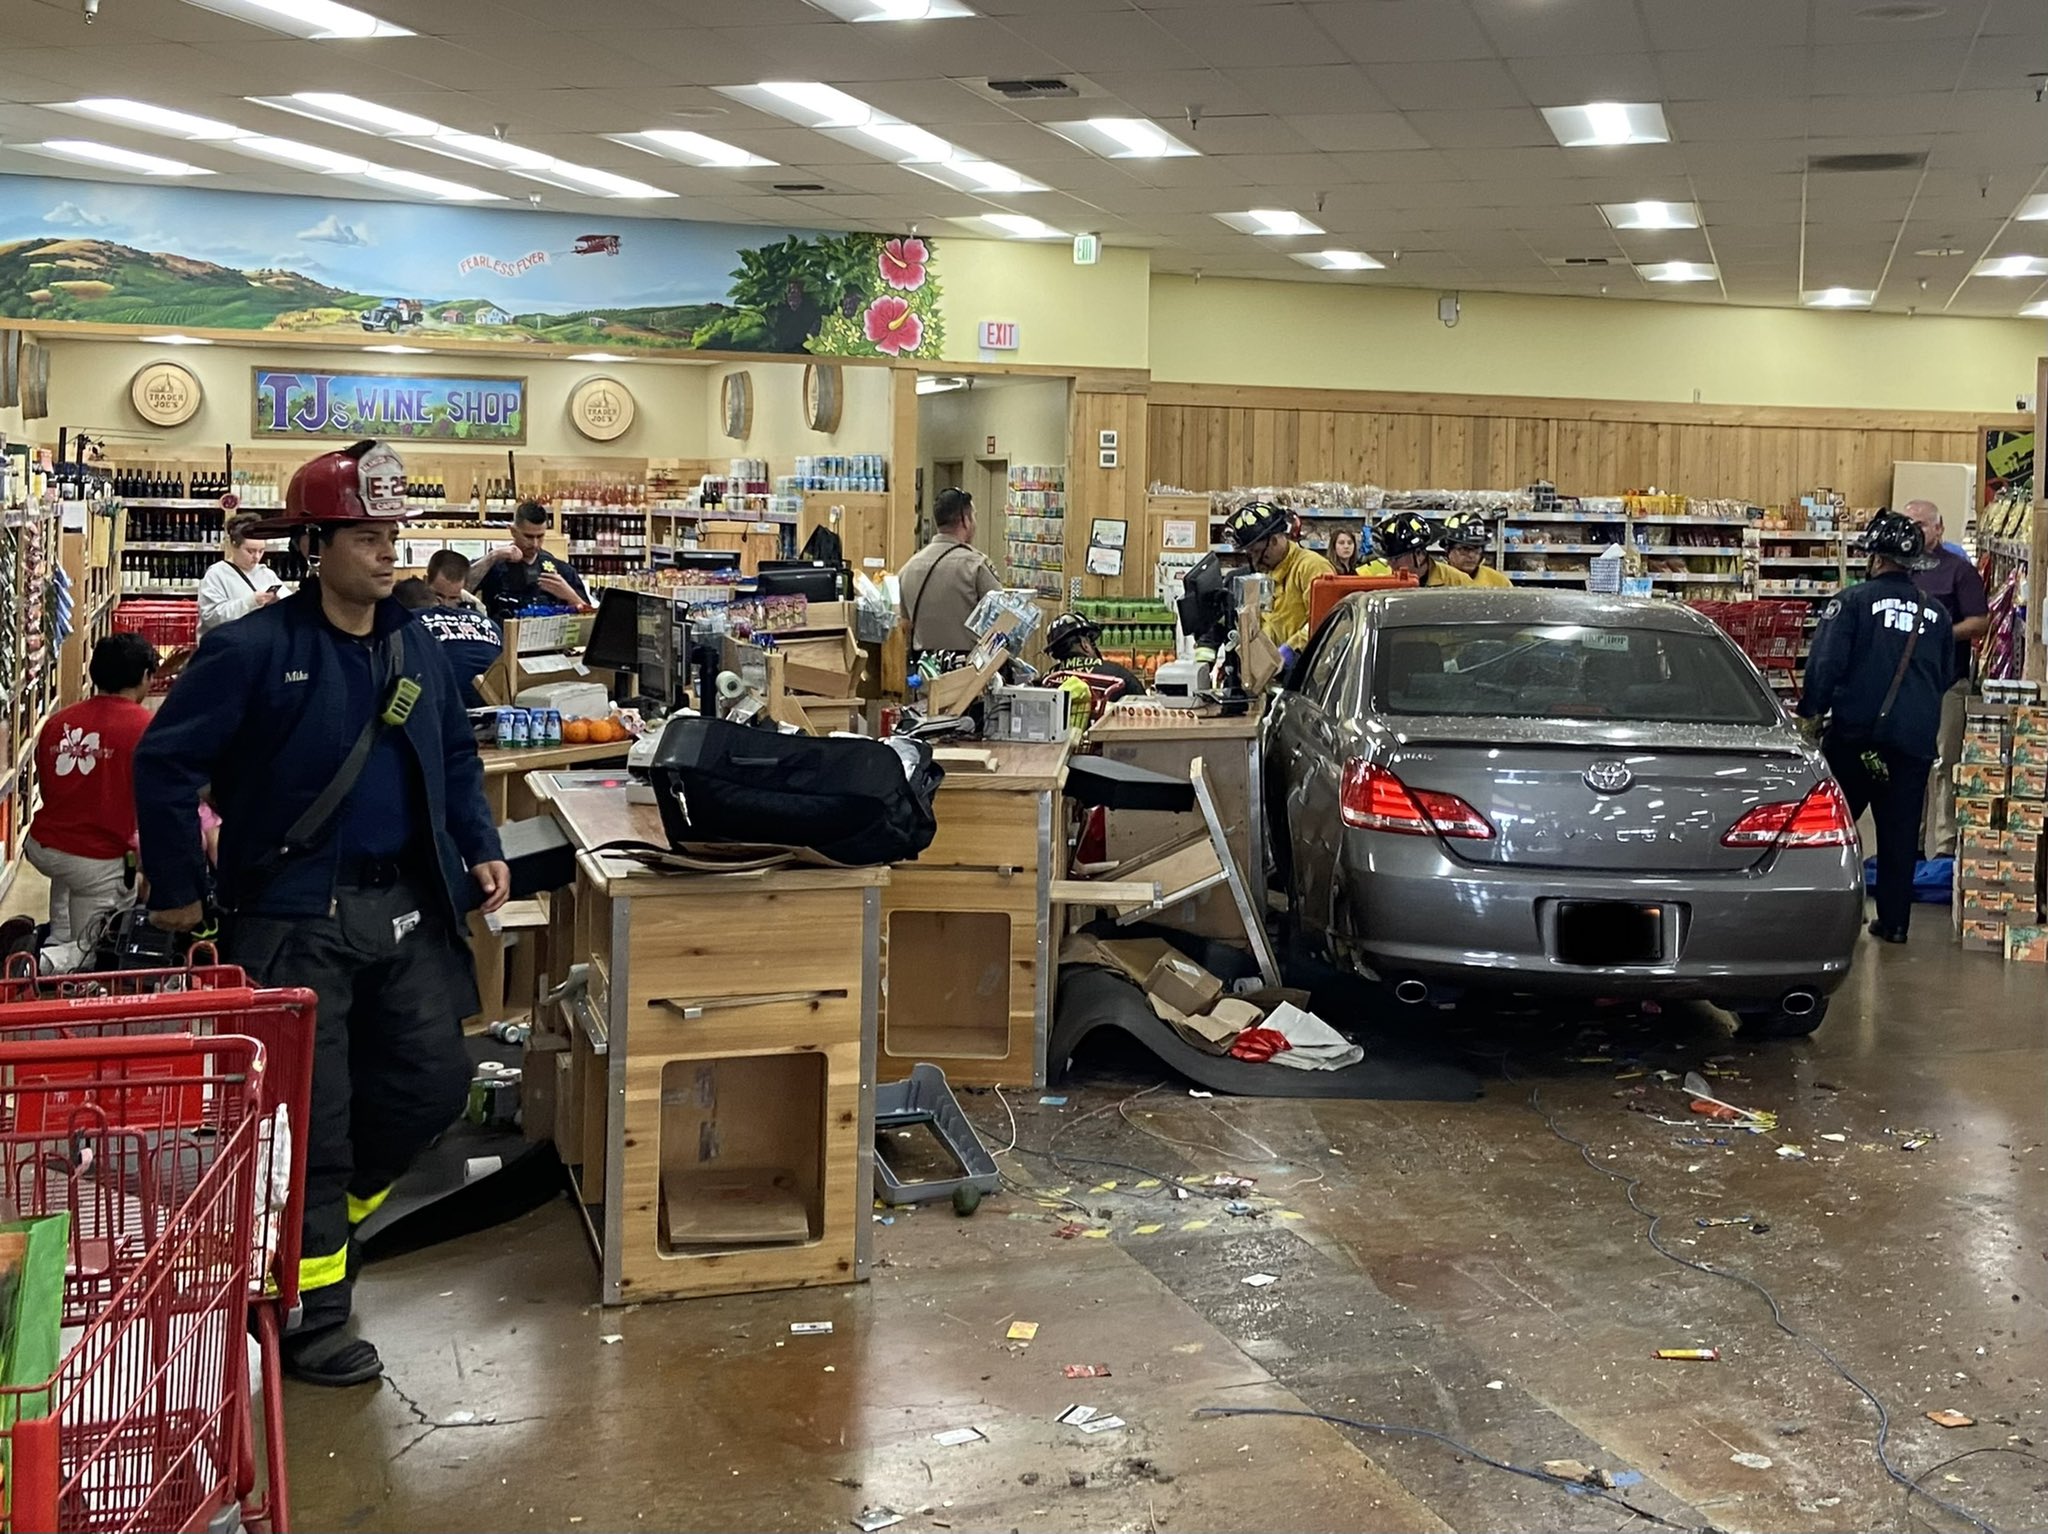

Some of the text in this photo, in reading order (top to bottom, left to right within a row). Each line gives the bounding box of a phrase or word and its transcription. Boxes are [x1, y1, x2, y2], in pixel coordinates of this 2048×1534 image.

[460, 251, 545, 277] FEARLESS FLYER
[987, 322, 1015, 346] EXIT
[149, 393, 184, 401] TRADER
[354, 387, 433, 423] WINE
[446, 391, 520, 427] SHOP
